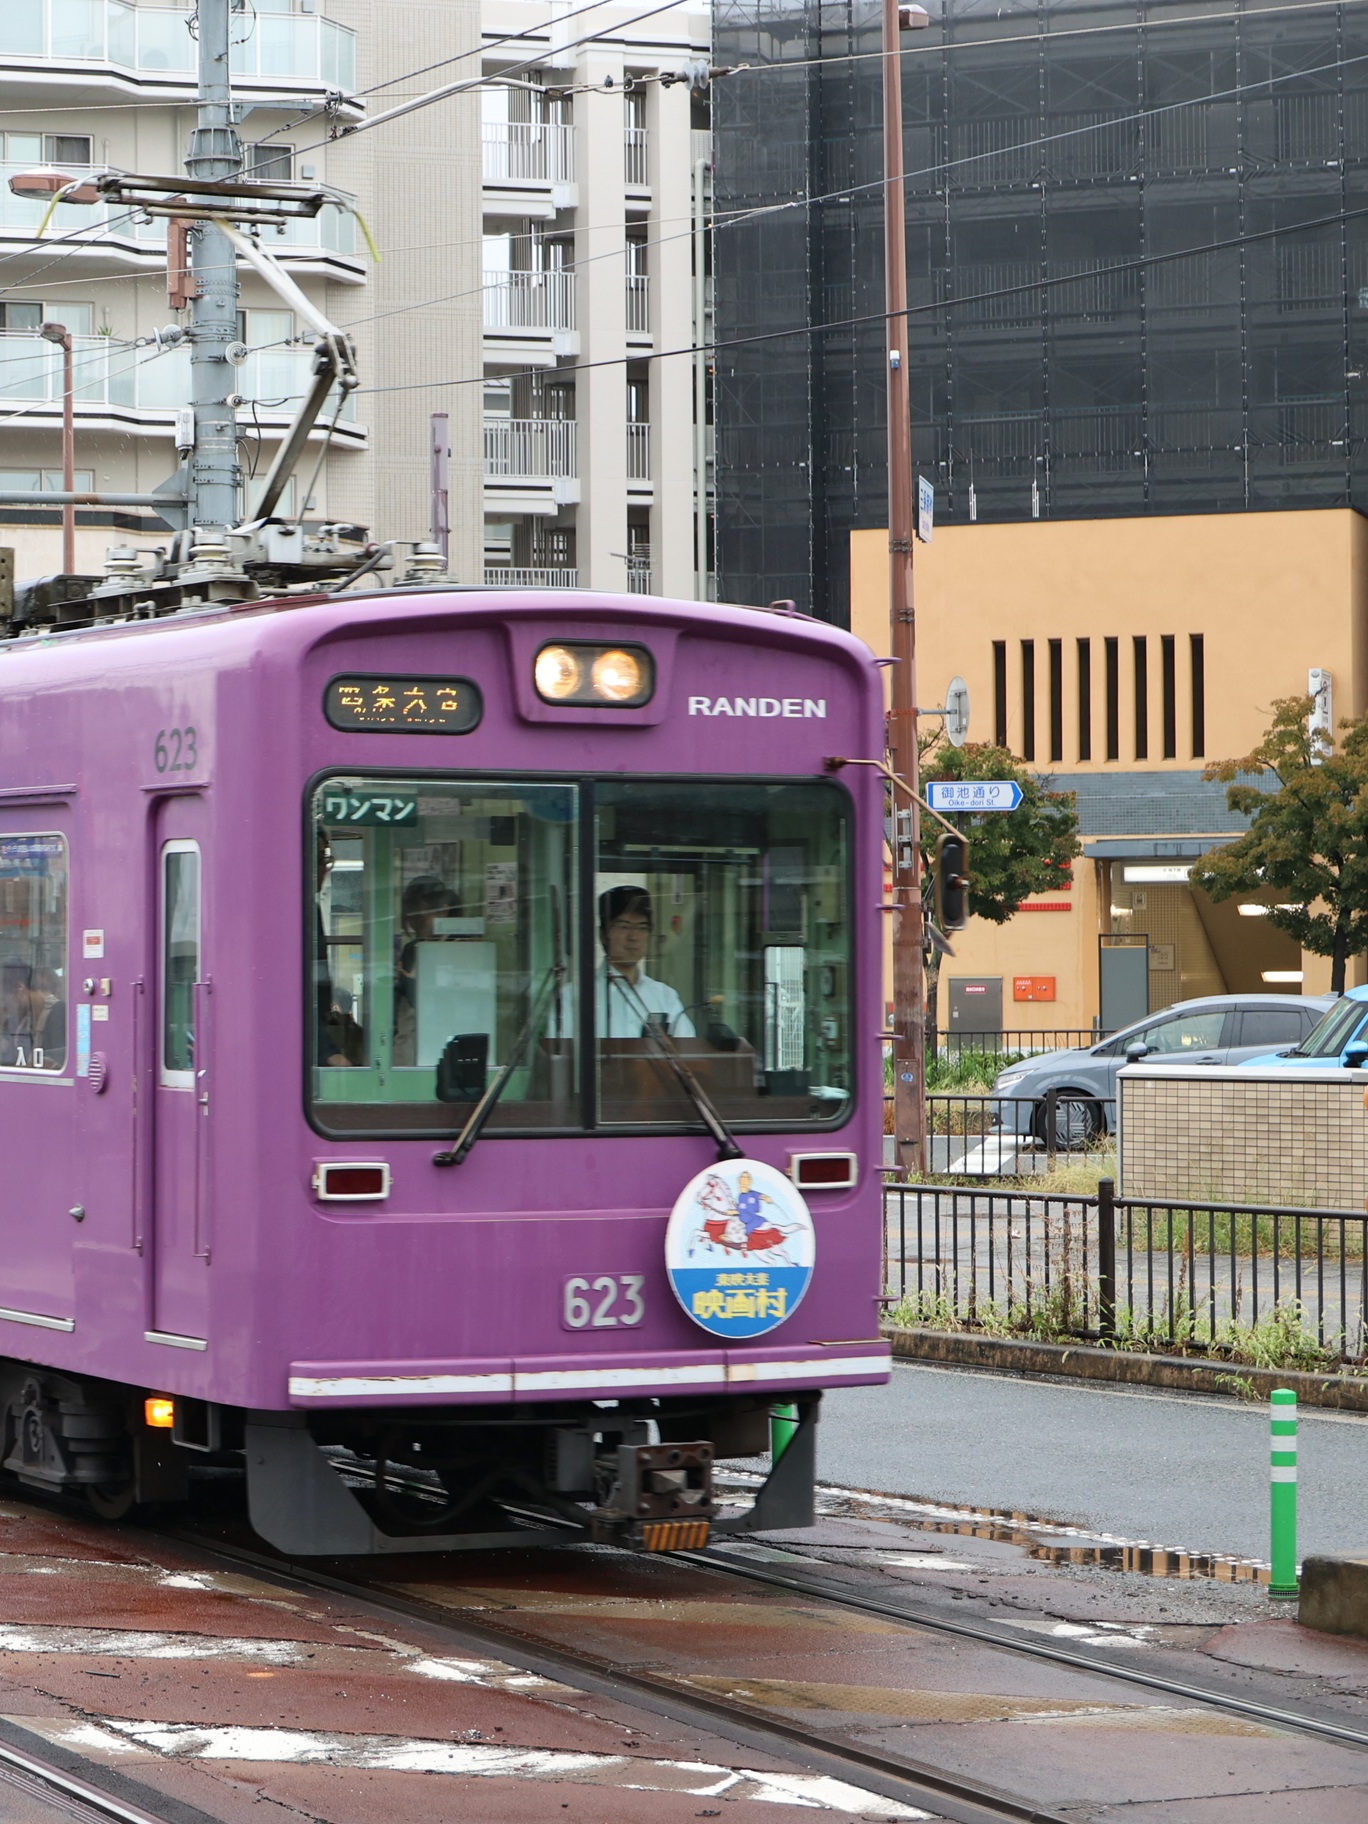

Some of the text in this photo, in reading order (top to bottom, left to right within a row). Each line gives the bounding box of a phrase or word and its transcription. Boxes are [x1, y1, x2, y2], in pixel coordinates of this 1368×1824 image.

[688, 696, 827, 718] RANDEN
[154, 726, 198, 773] 623
[941, 786, 1000, 799] 御池通り
[326, 797, 416, 821] ワンマン
[16, 1046, 44, 1067] 入口
[564, 1275, 645, 1328] 623
[692, 1287, 788, 1319] 映画村
